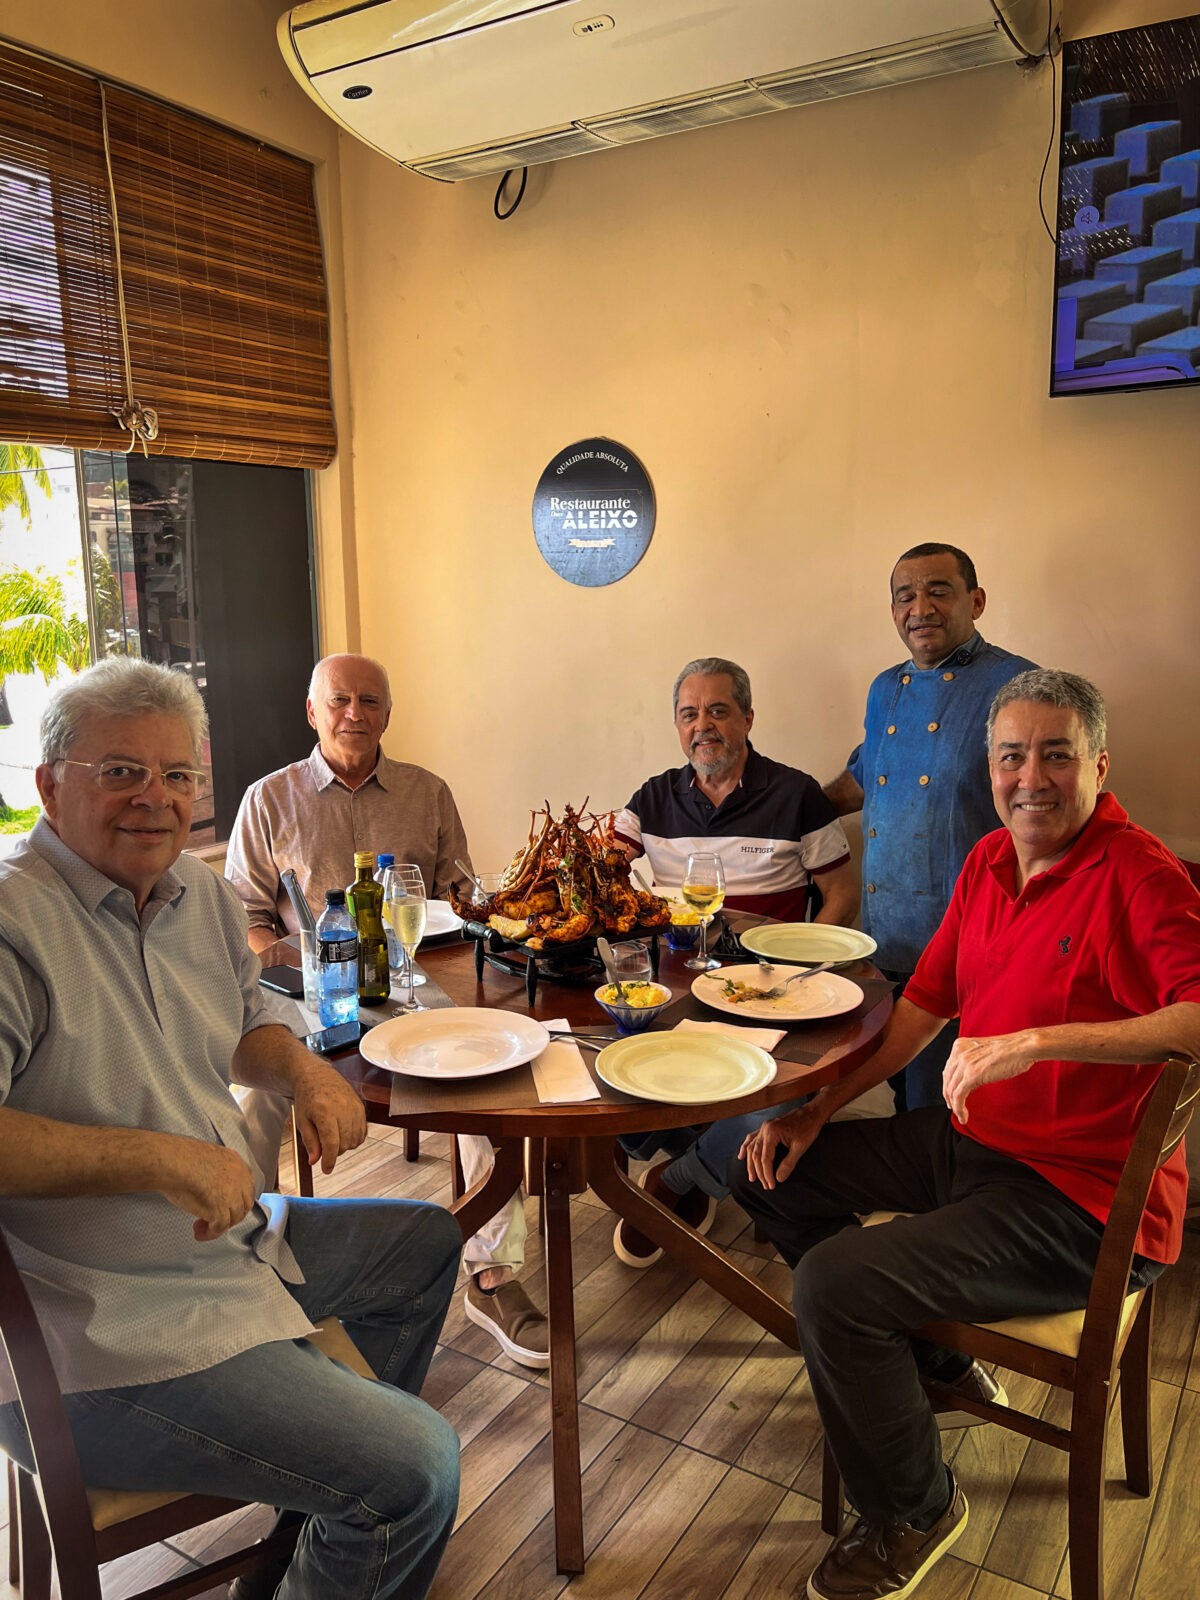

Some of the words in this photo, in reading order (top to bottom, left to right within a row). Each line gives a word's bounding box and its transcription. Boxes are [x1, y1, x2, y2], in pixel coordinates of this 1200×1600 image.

[556, 451, 594, 475] QUALIDADE
[595, 451, 629, 473] ABSOLUTA
[550, 497, 631, 511] Restaurante
[562, 510, 638, 529] ALEIXO
